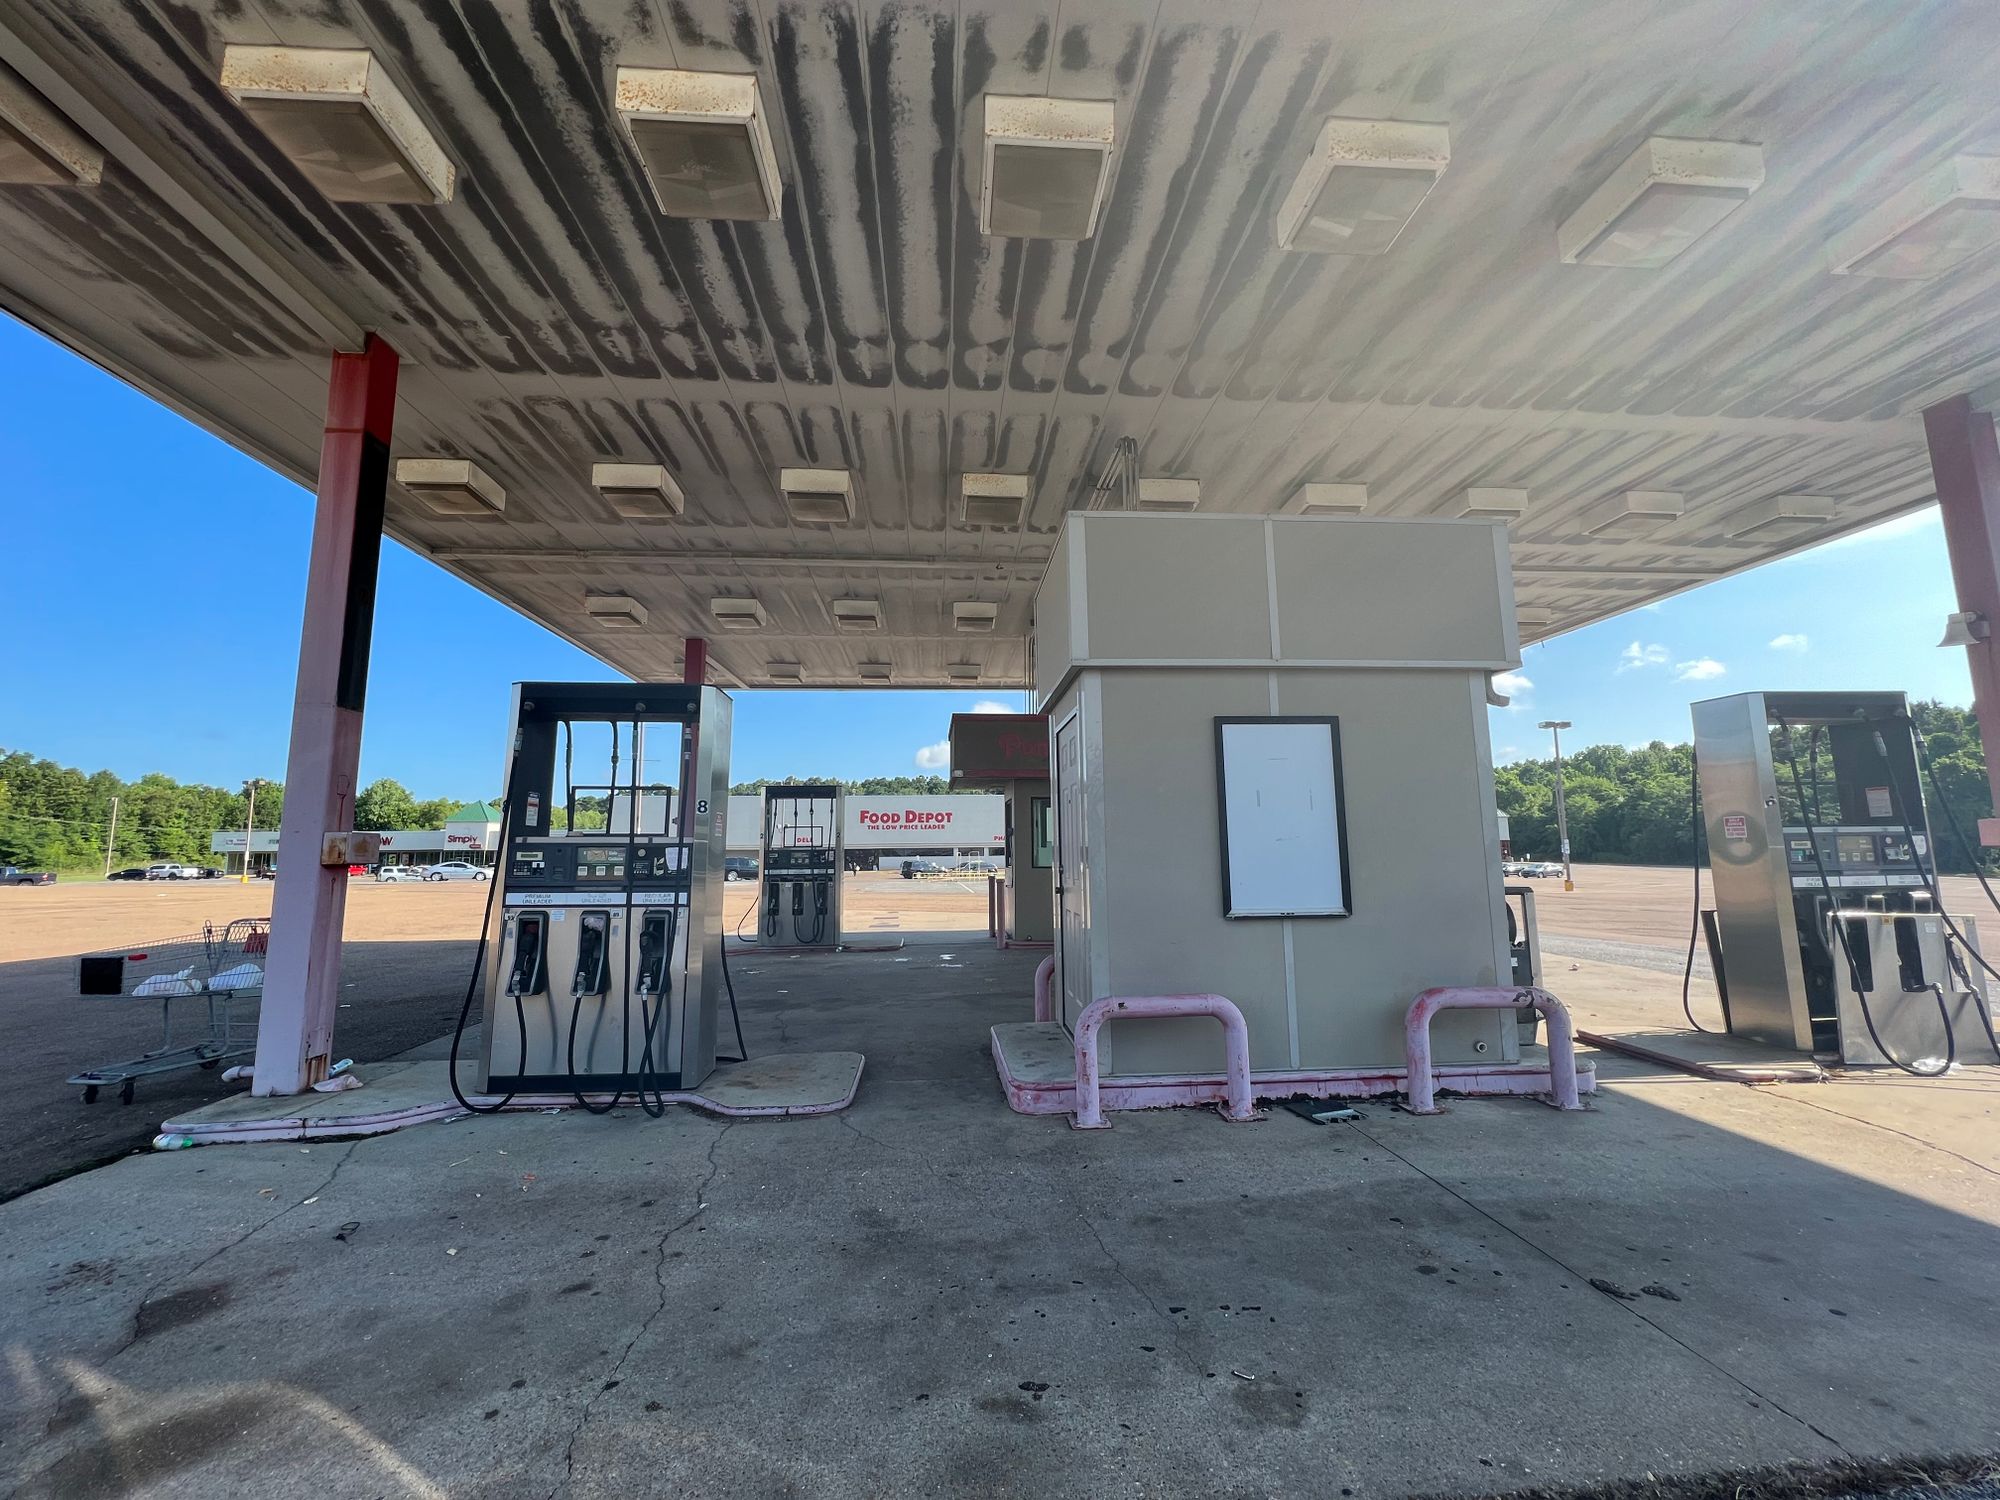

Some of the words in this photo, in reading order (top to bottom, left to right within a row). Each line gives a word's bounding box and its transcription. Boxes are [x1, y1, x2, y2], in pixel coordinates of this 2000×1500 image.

[698, 800, 708, 813] 8
[860, 810, 901, 824] FOOD
[905, 810, 953, 823] DEPOT
[447, 834, 478, 844] Simply
